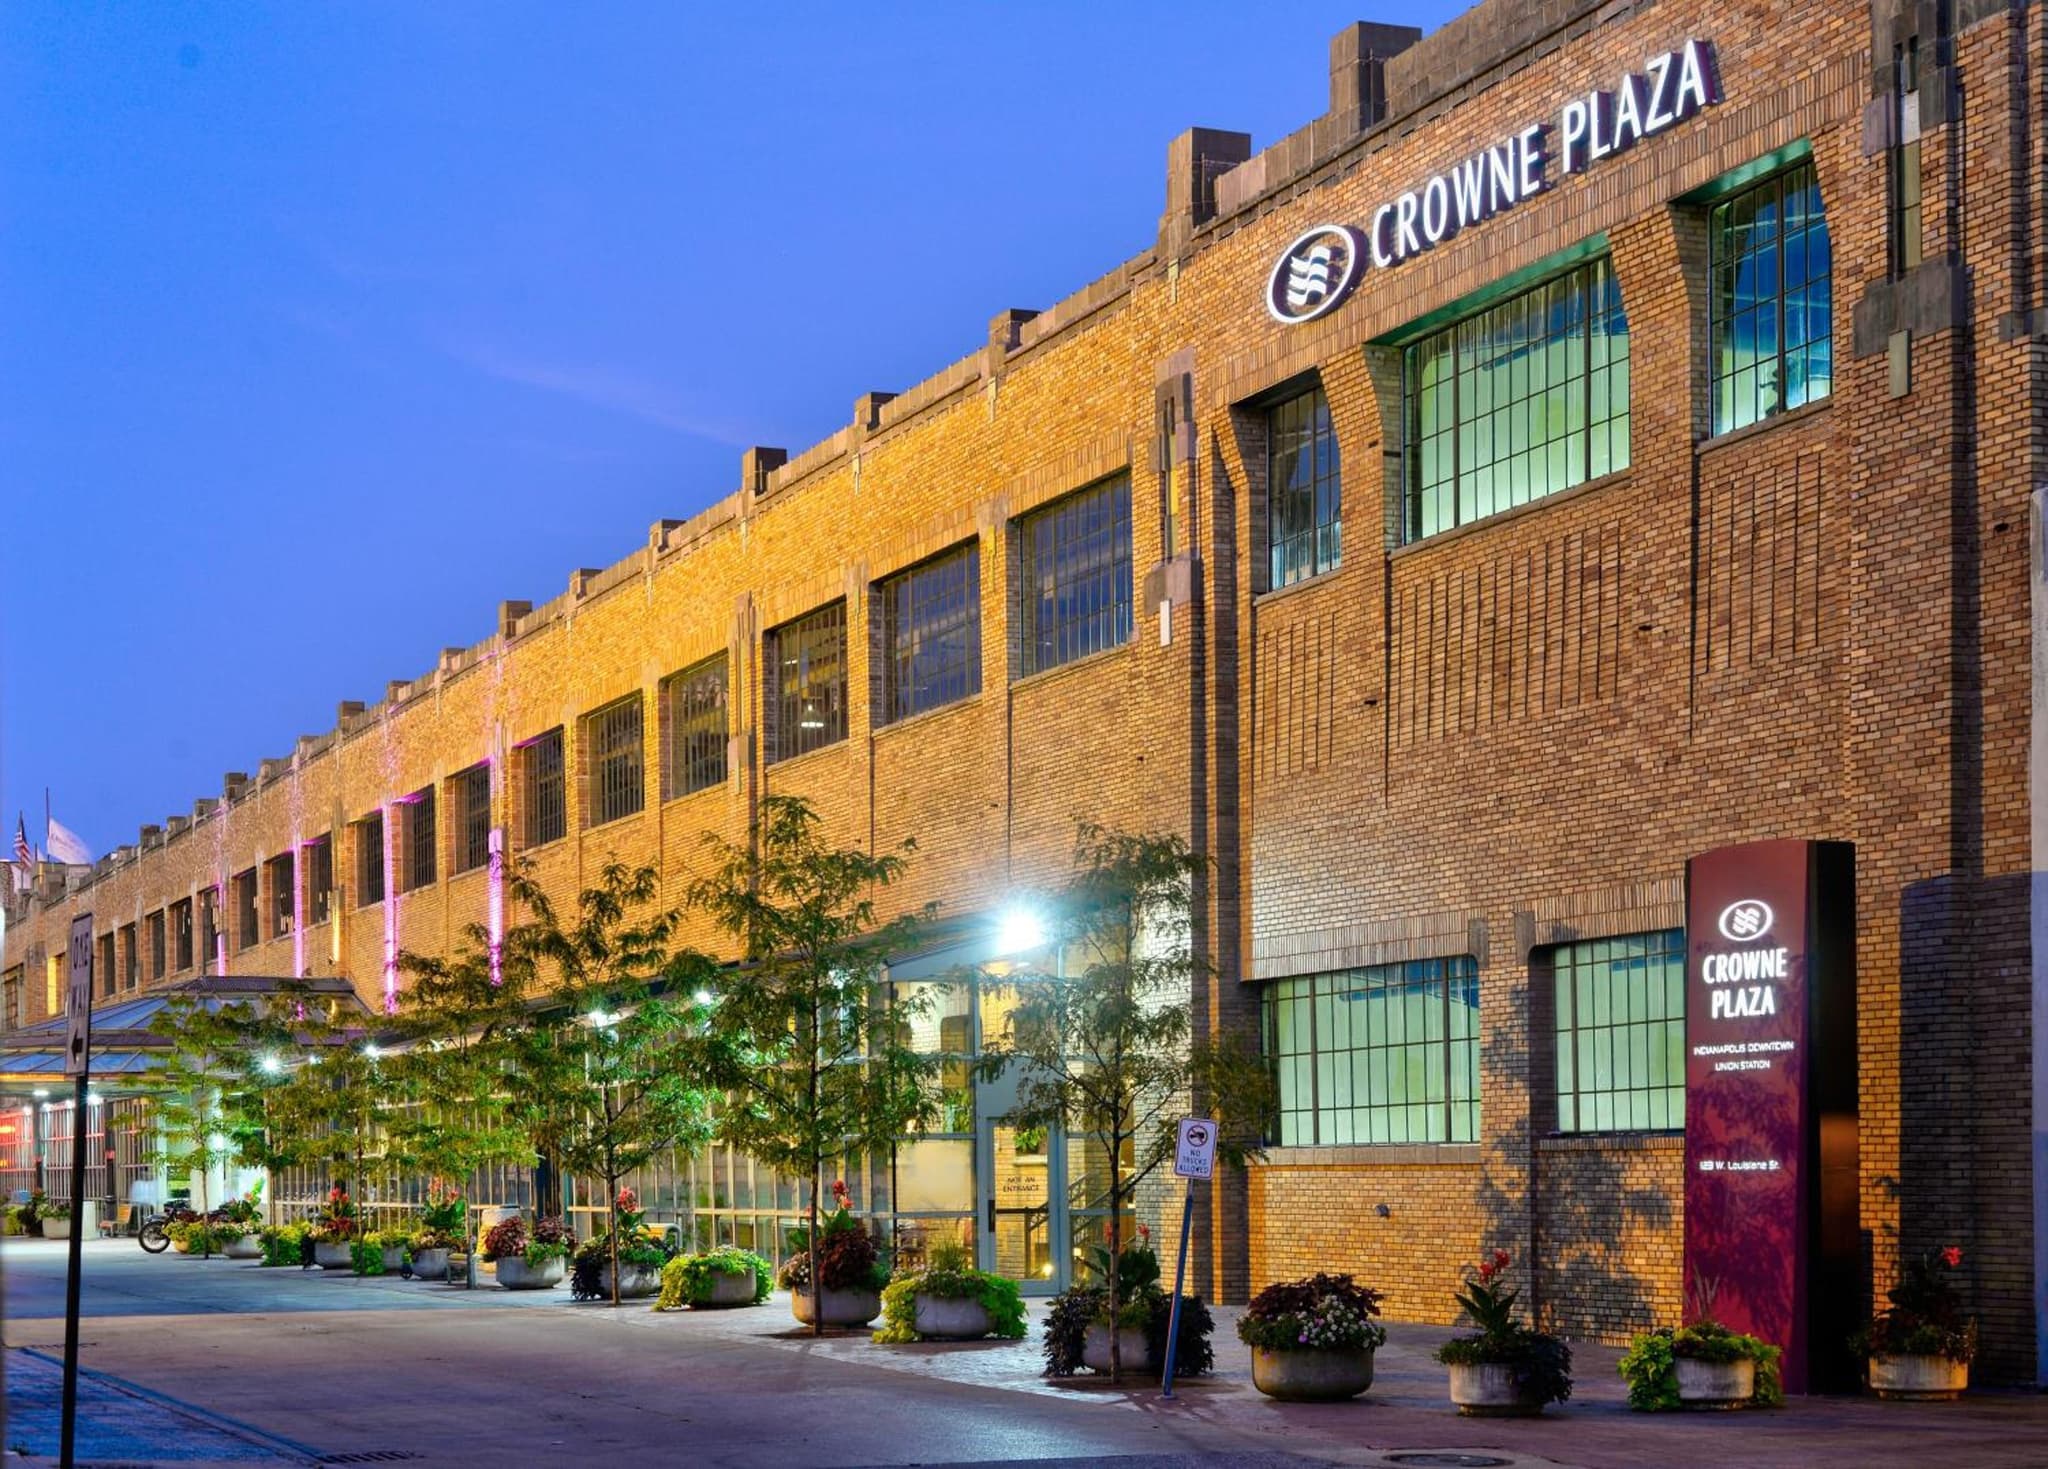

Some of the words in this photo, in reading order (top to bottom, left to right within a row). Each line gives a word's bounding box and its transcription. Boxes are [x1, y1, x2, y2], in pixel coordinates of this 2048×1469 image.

[1370, 123, 1545, 269] CROWNE
[1562, 38, 1713, 174] PLAZA
[73, 931, 90, 970] ONE
[1702, 948, 1788, 984] CROWNE
[71, 983, 89, 1018] WAY
[1711, 985, 1776, 1019] PLAZA
[1693, 1043, 1746, 1056] INDIANAPOLIS
[1747, 1040, 1795, 1053] DOWNTOWN
[1715, 1061, 1739, 1072] UNION
[1740, 1060, 1771, 1071] STATION
[1190, 1149, 1201, 1157] NO
